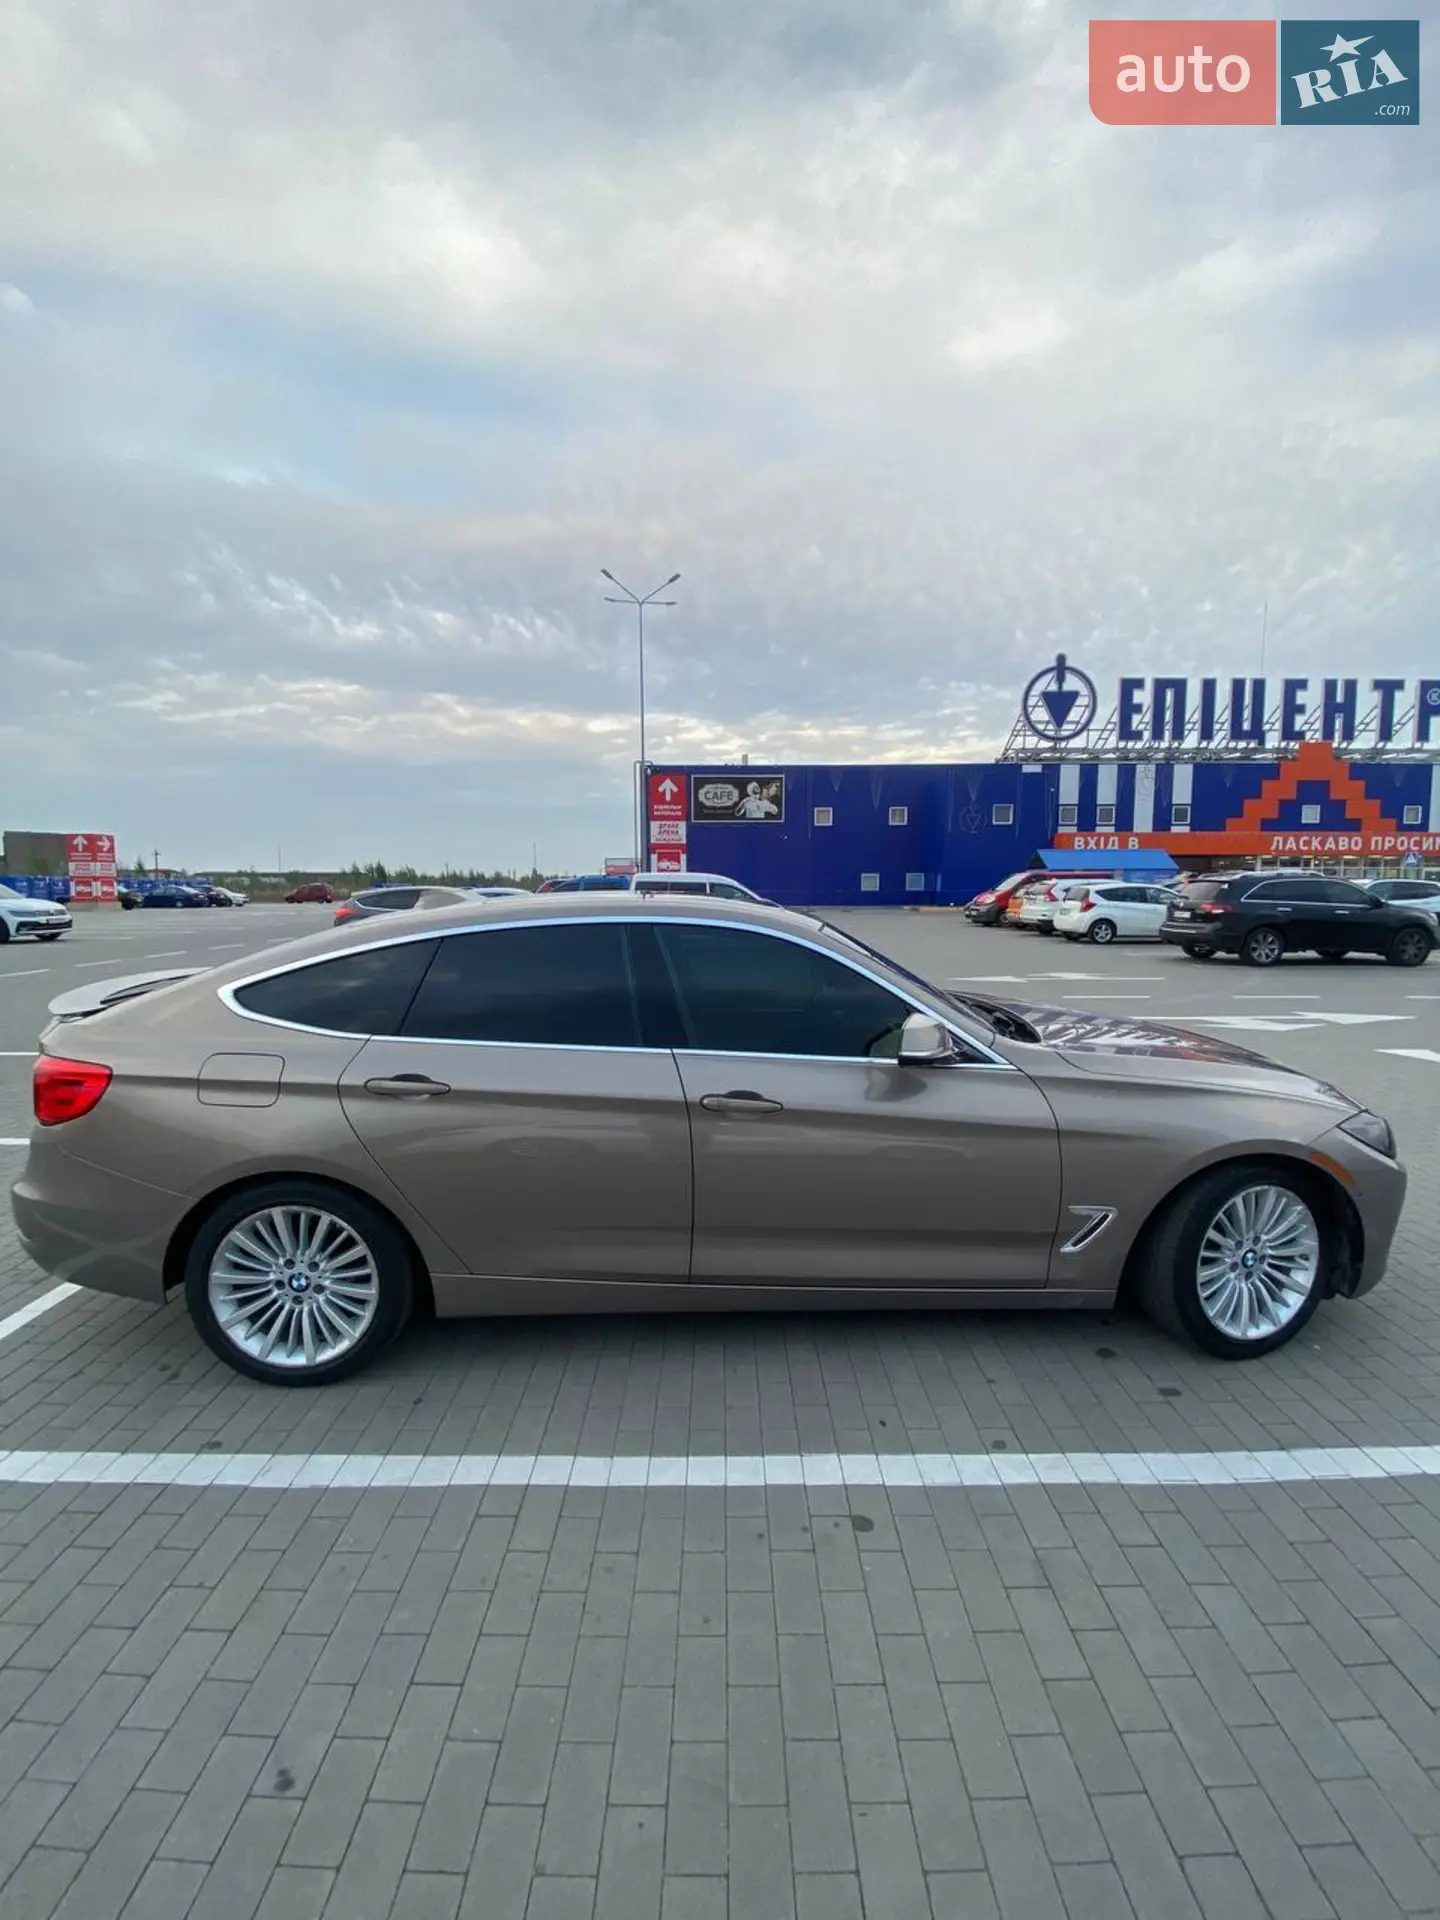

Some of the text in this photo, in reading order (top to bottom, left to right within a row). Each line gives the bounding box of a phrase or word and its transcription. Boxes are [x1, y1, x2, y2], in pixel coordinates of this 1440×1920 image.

[1118, 677, 1440, 746] ЕПІЦЕНТР
[704, 791, 734, 800] CAFE
[1074, 836, 1140, 850] ВХІД В
[1270, 836, 1363, 851] ЛАСКАВО
